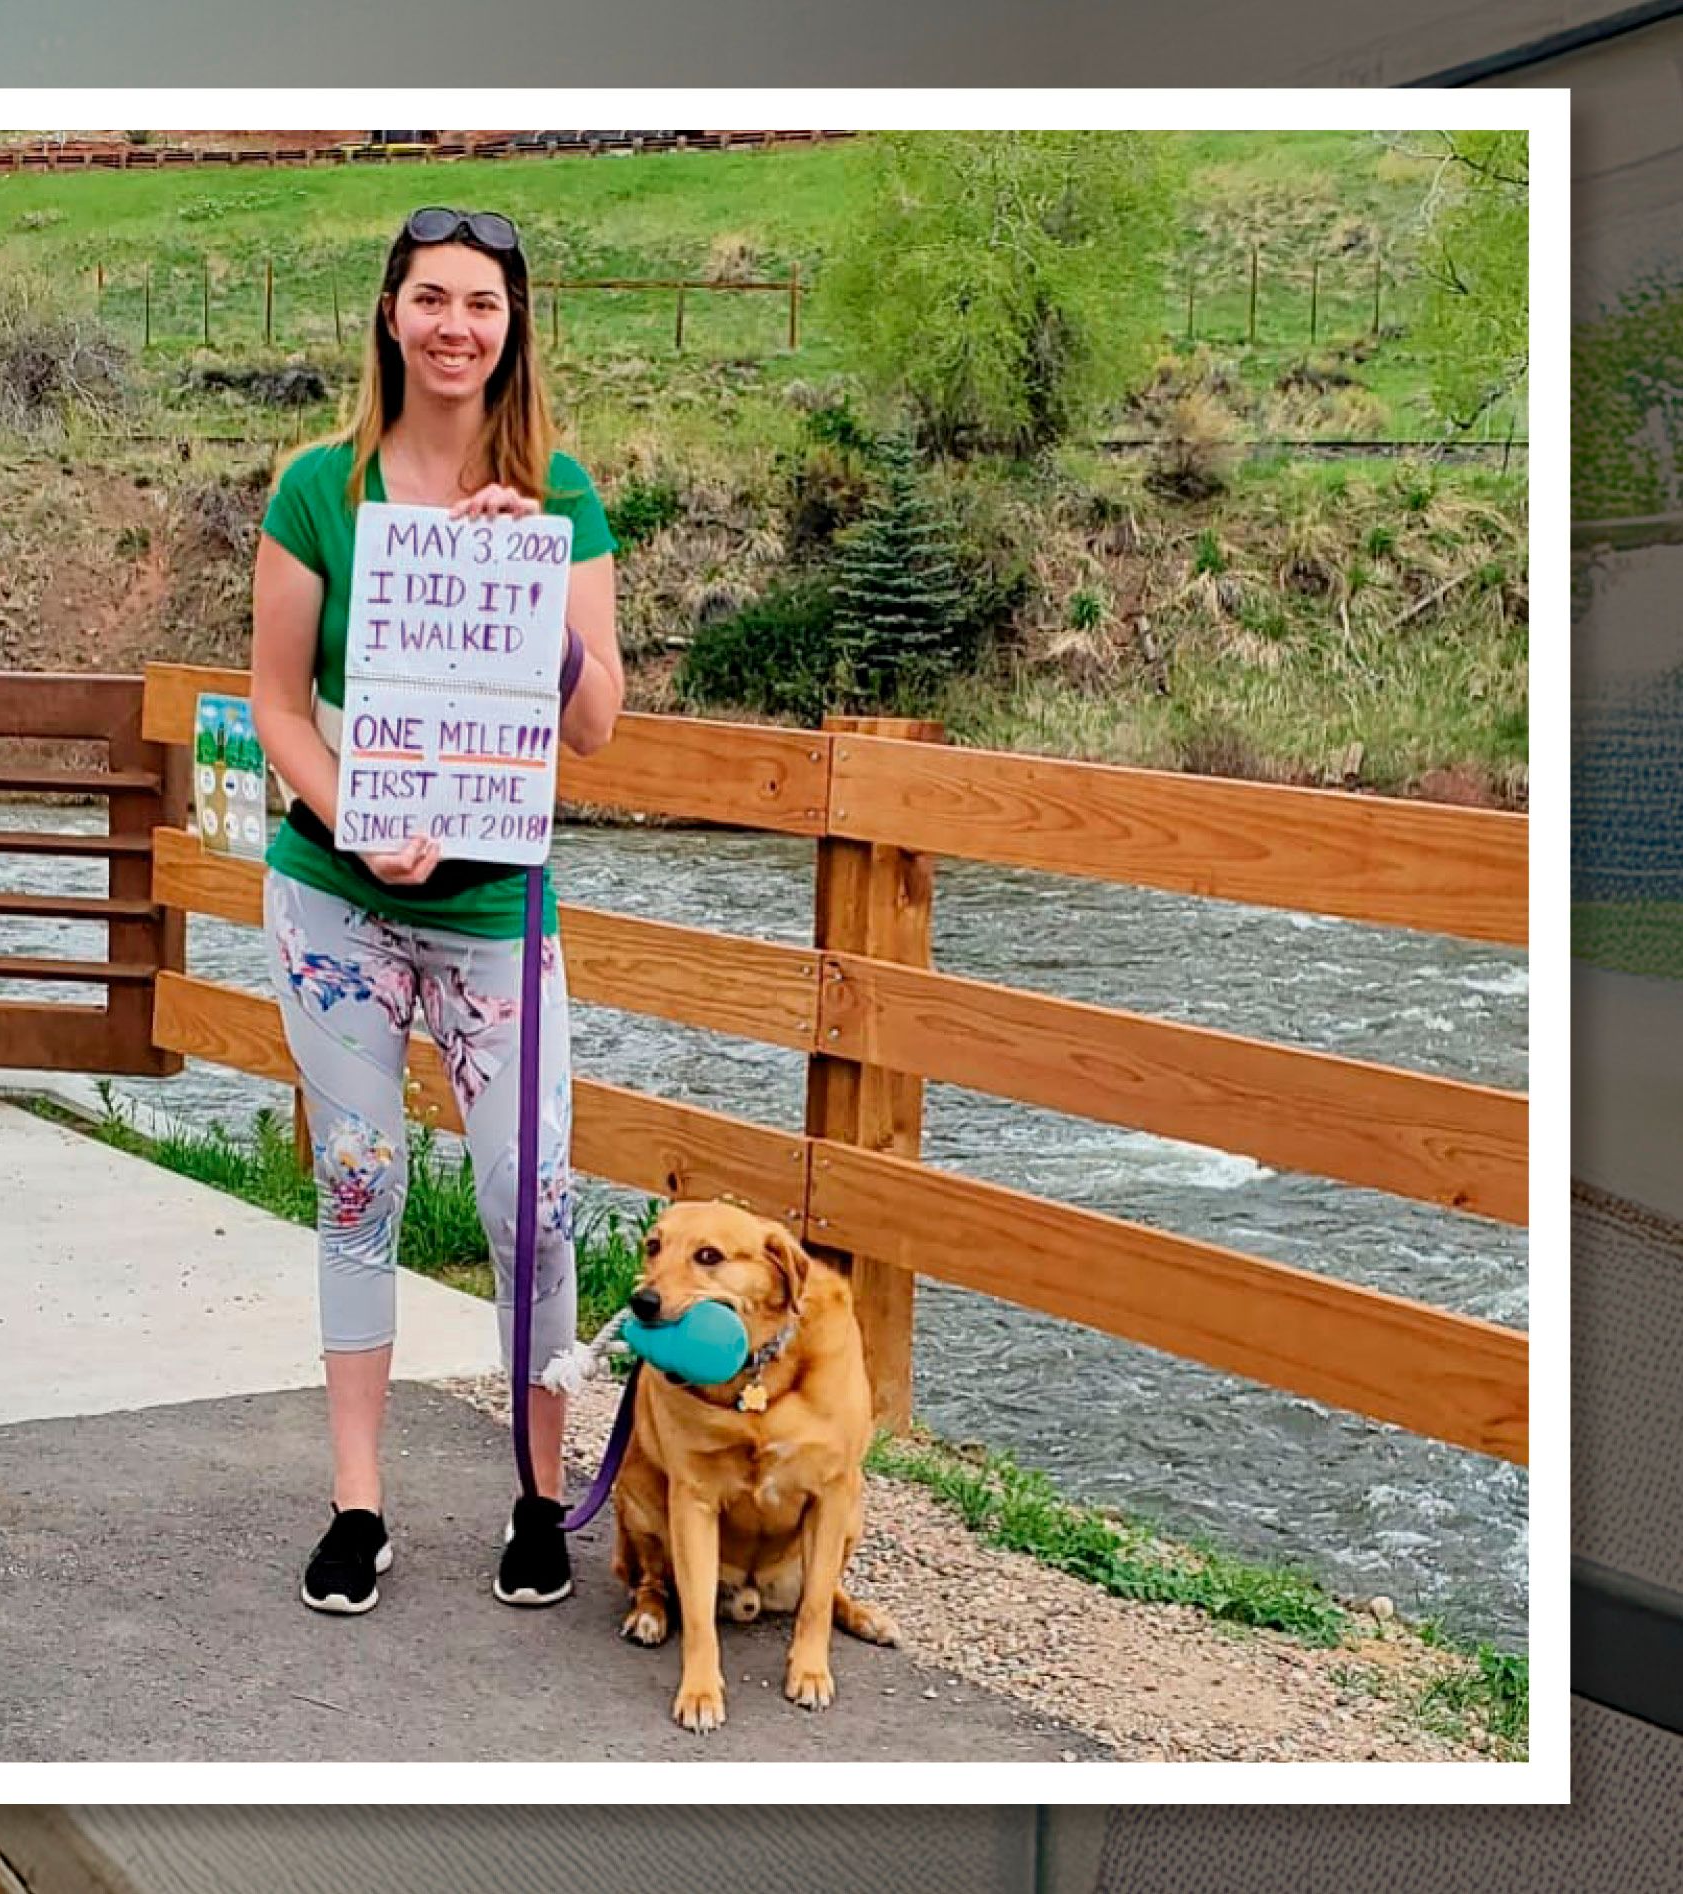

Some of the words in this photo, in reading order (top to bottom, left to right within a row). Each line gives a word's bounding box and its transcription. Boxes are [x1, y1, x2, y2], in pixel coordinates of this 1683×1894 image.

[387, 522, 464, 558] MAY
[507, 534, 568, 564] 2020
[367, 571, 394, 604] I
[406, 574, 467, 608] DID
[478, 582, 542, 617] IT!
[366, 619, 392, 651] I
[401, 622, 524, 653] WALKED
[352, 715, 424, 749] ONE
[439, 721, 552, 758] MILE!!!
[350, 769, 437, 801] FIRST
[452, 774, 525, 803] TIME
[343, 810, 415, 844] SINCE
